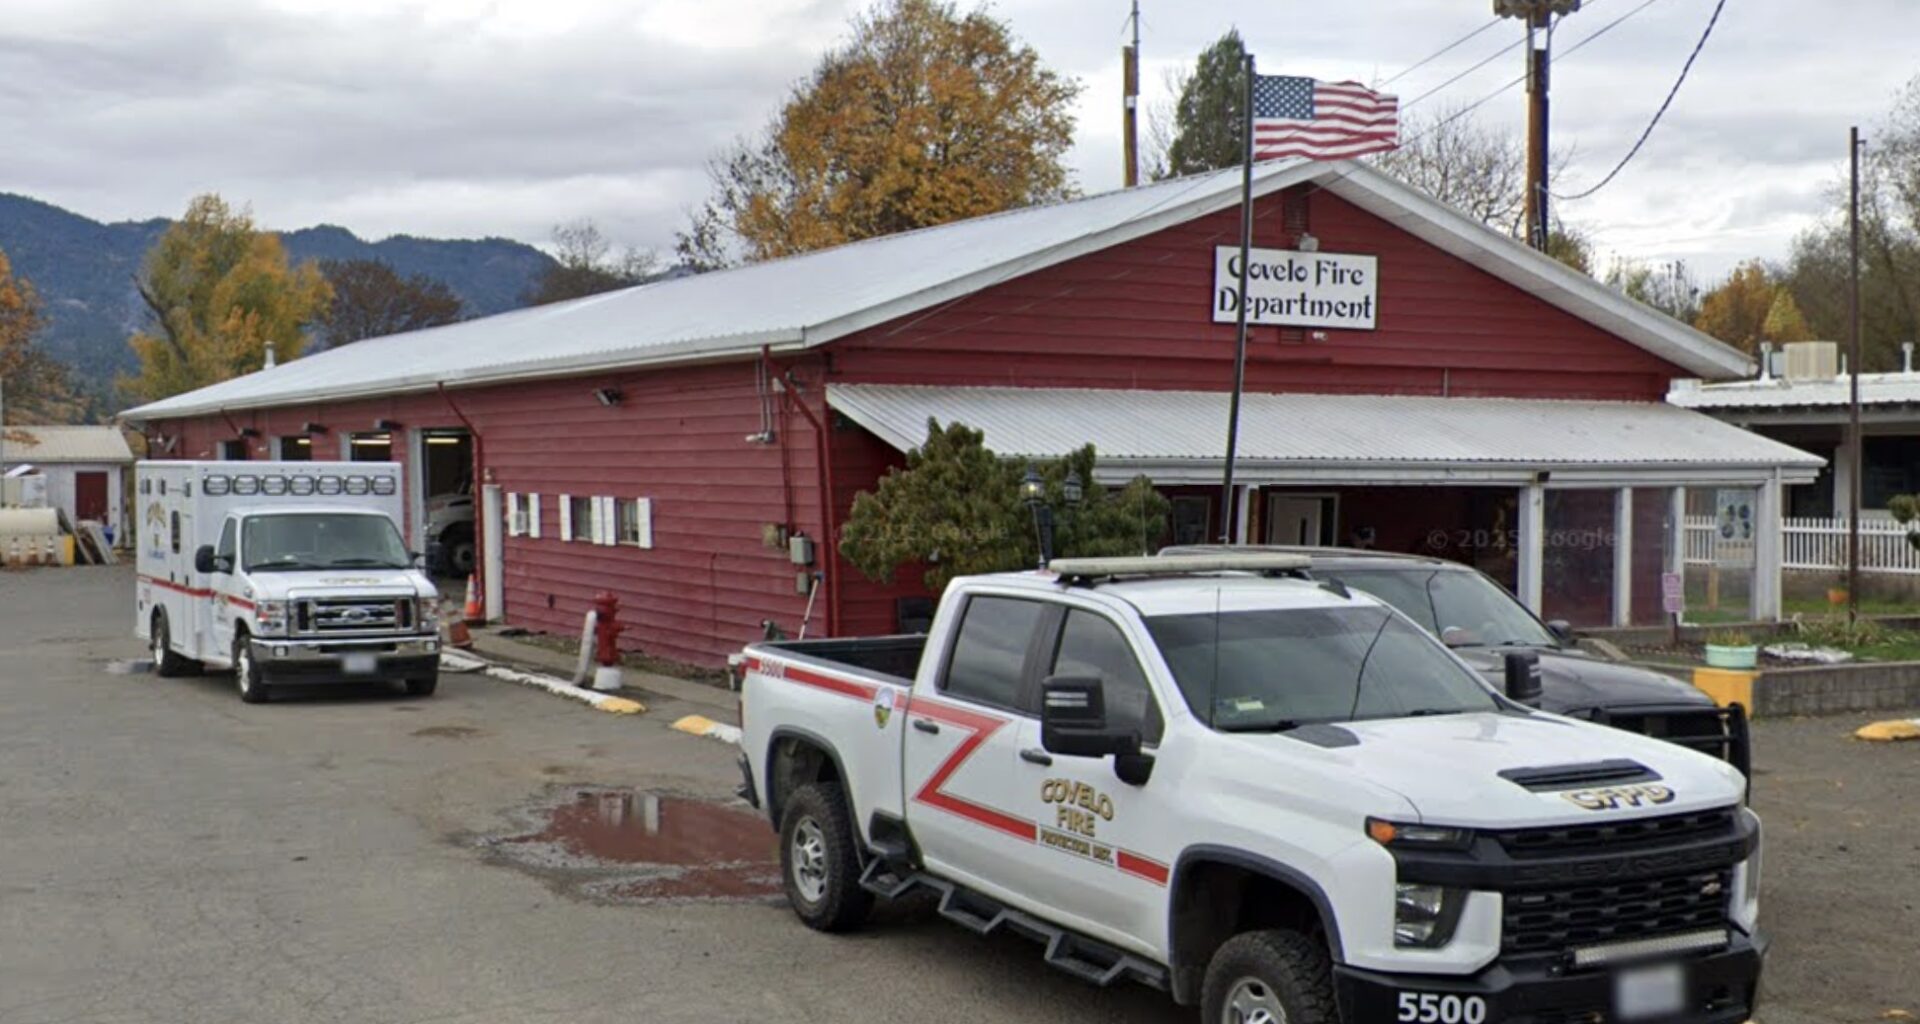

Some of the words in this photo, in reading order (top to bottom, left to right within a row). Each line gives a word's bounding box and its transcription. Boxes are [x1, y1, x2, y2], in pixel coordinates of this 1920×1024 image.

[1228, 255, 1308, 283] Covelo
[1316, 259, 1364, 287] Fire
[1219, 286, 1372, 320] Department
[1041, 778, 1114, 821] COVELO
[1057, 804, 1096, 837] FIRE
[1397, 992, 1487, 1024] 5500
